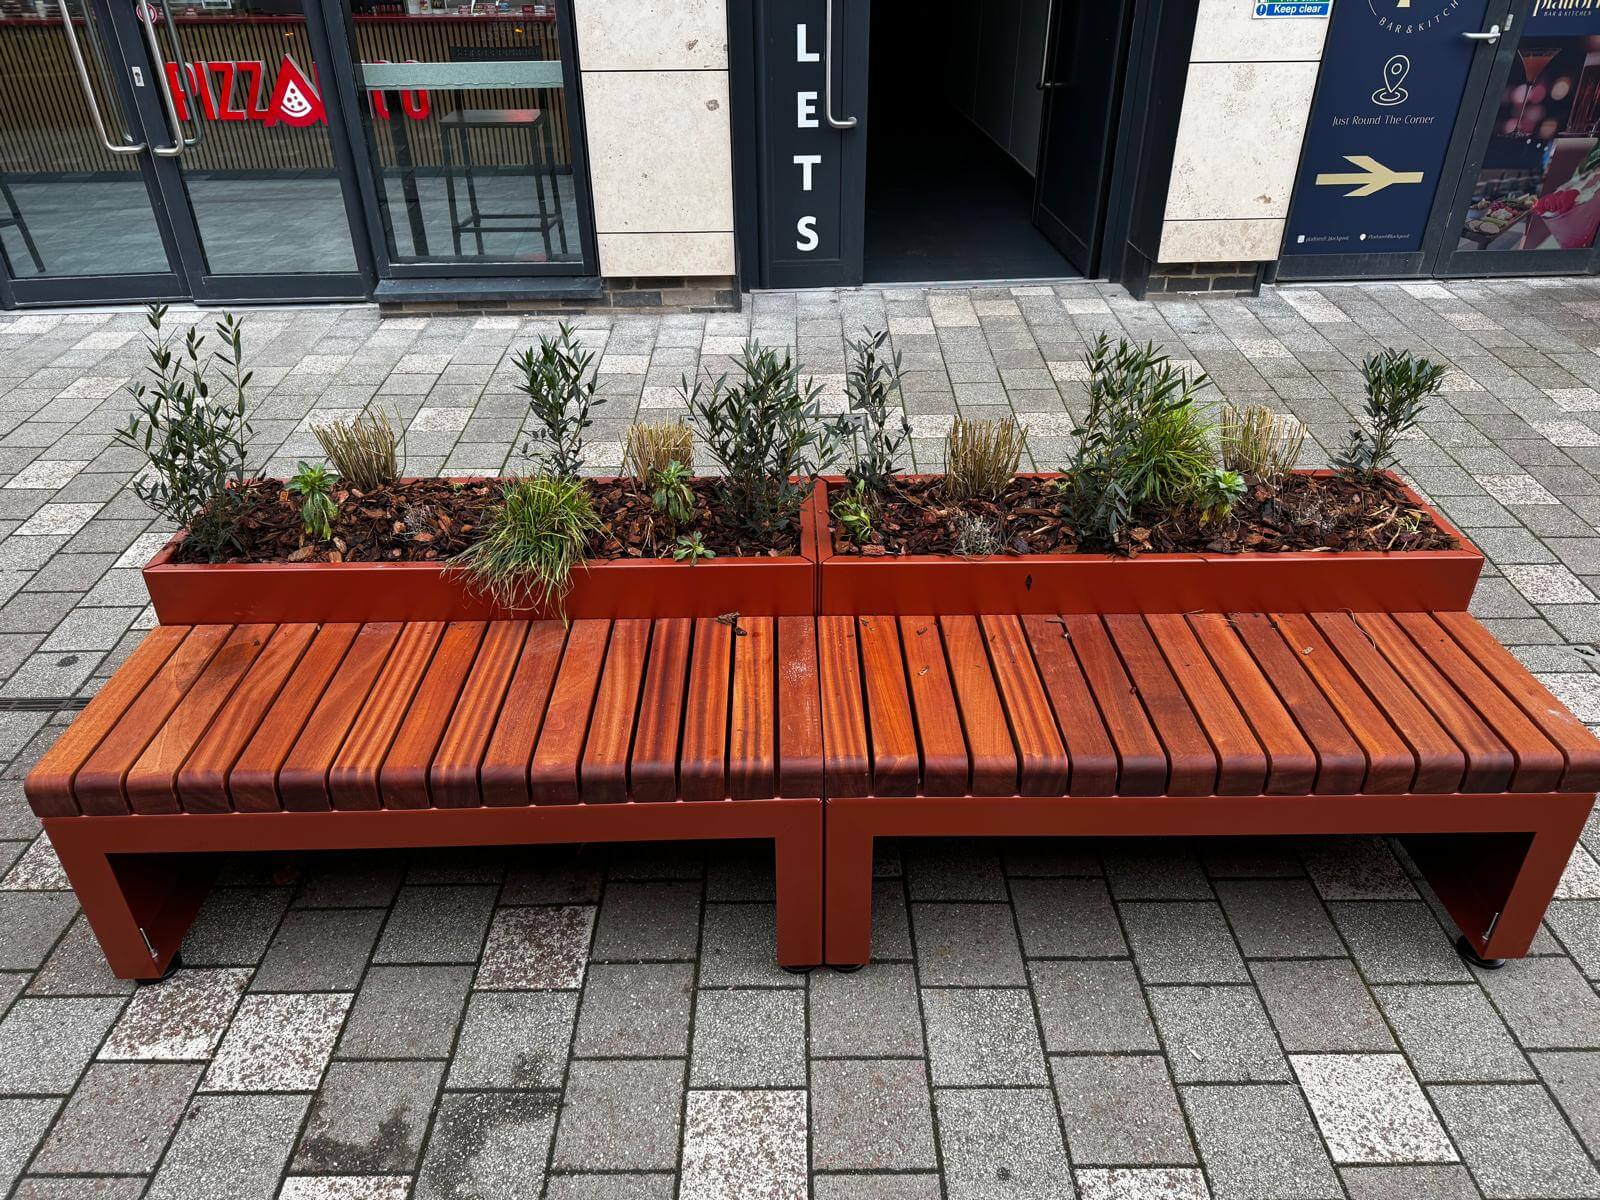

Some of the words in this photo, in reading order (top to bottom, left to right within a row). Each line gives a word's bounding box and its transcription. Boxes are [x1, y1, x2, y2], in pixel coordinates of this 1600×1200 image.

[1273, 4, 1297, 15] Keep
[1298, 4, 1323, 14] clear
[1378, 16, 1402, 34] BAR
[1406, 24, 1413, 34] &
[1332, 115, 1350, 127] Just
[1351, 115, 1381, 125] Round
[1384, 114, 1402, 125] The
[1404, 114, 1435, 125] Corner
[793, 23, 822, 252] LETS
